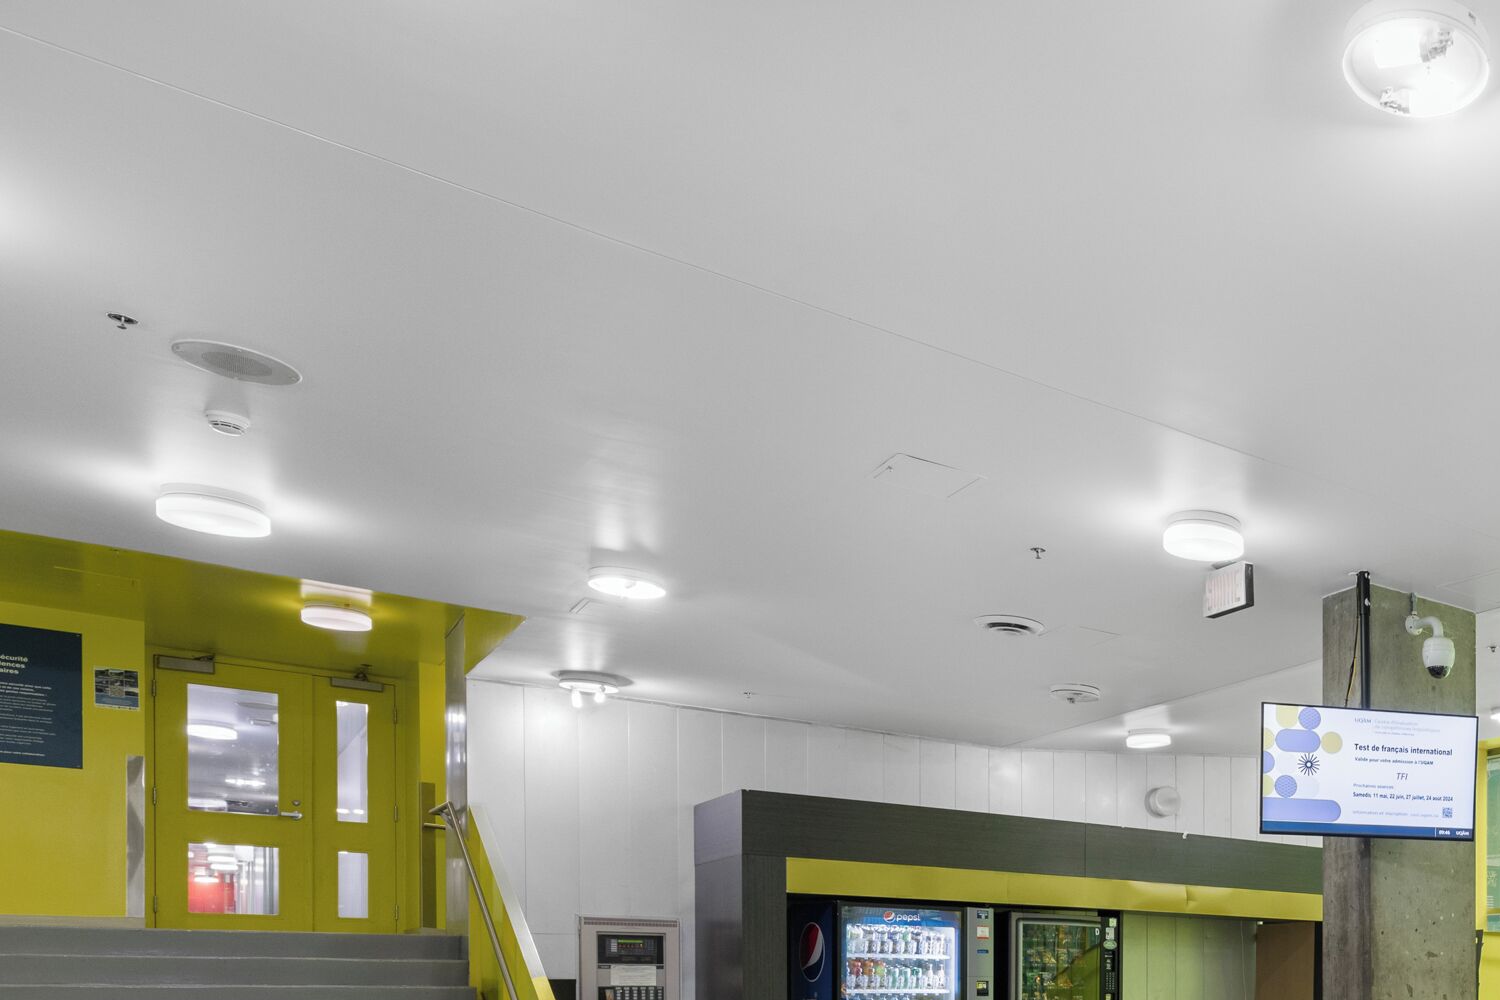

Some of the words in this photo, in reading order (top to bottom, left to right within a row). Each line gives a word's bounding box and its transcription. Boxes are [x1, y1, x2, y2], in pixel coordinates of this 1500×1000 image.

[1354, 743, 1370, 751] Test
[1371, 744, 1380, 752] de
[1381, 745, 1409, 754] français
[1410, 746, 1453, 756] international
[1396, 772, 1409, 781] TFI
[896, 914, 920, 922] pepsi
